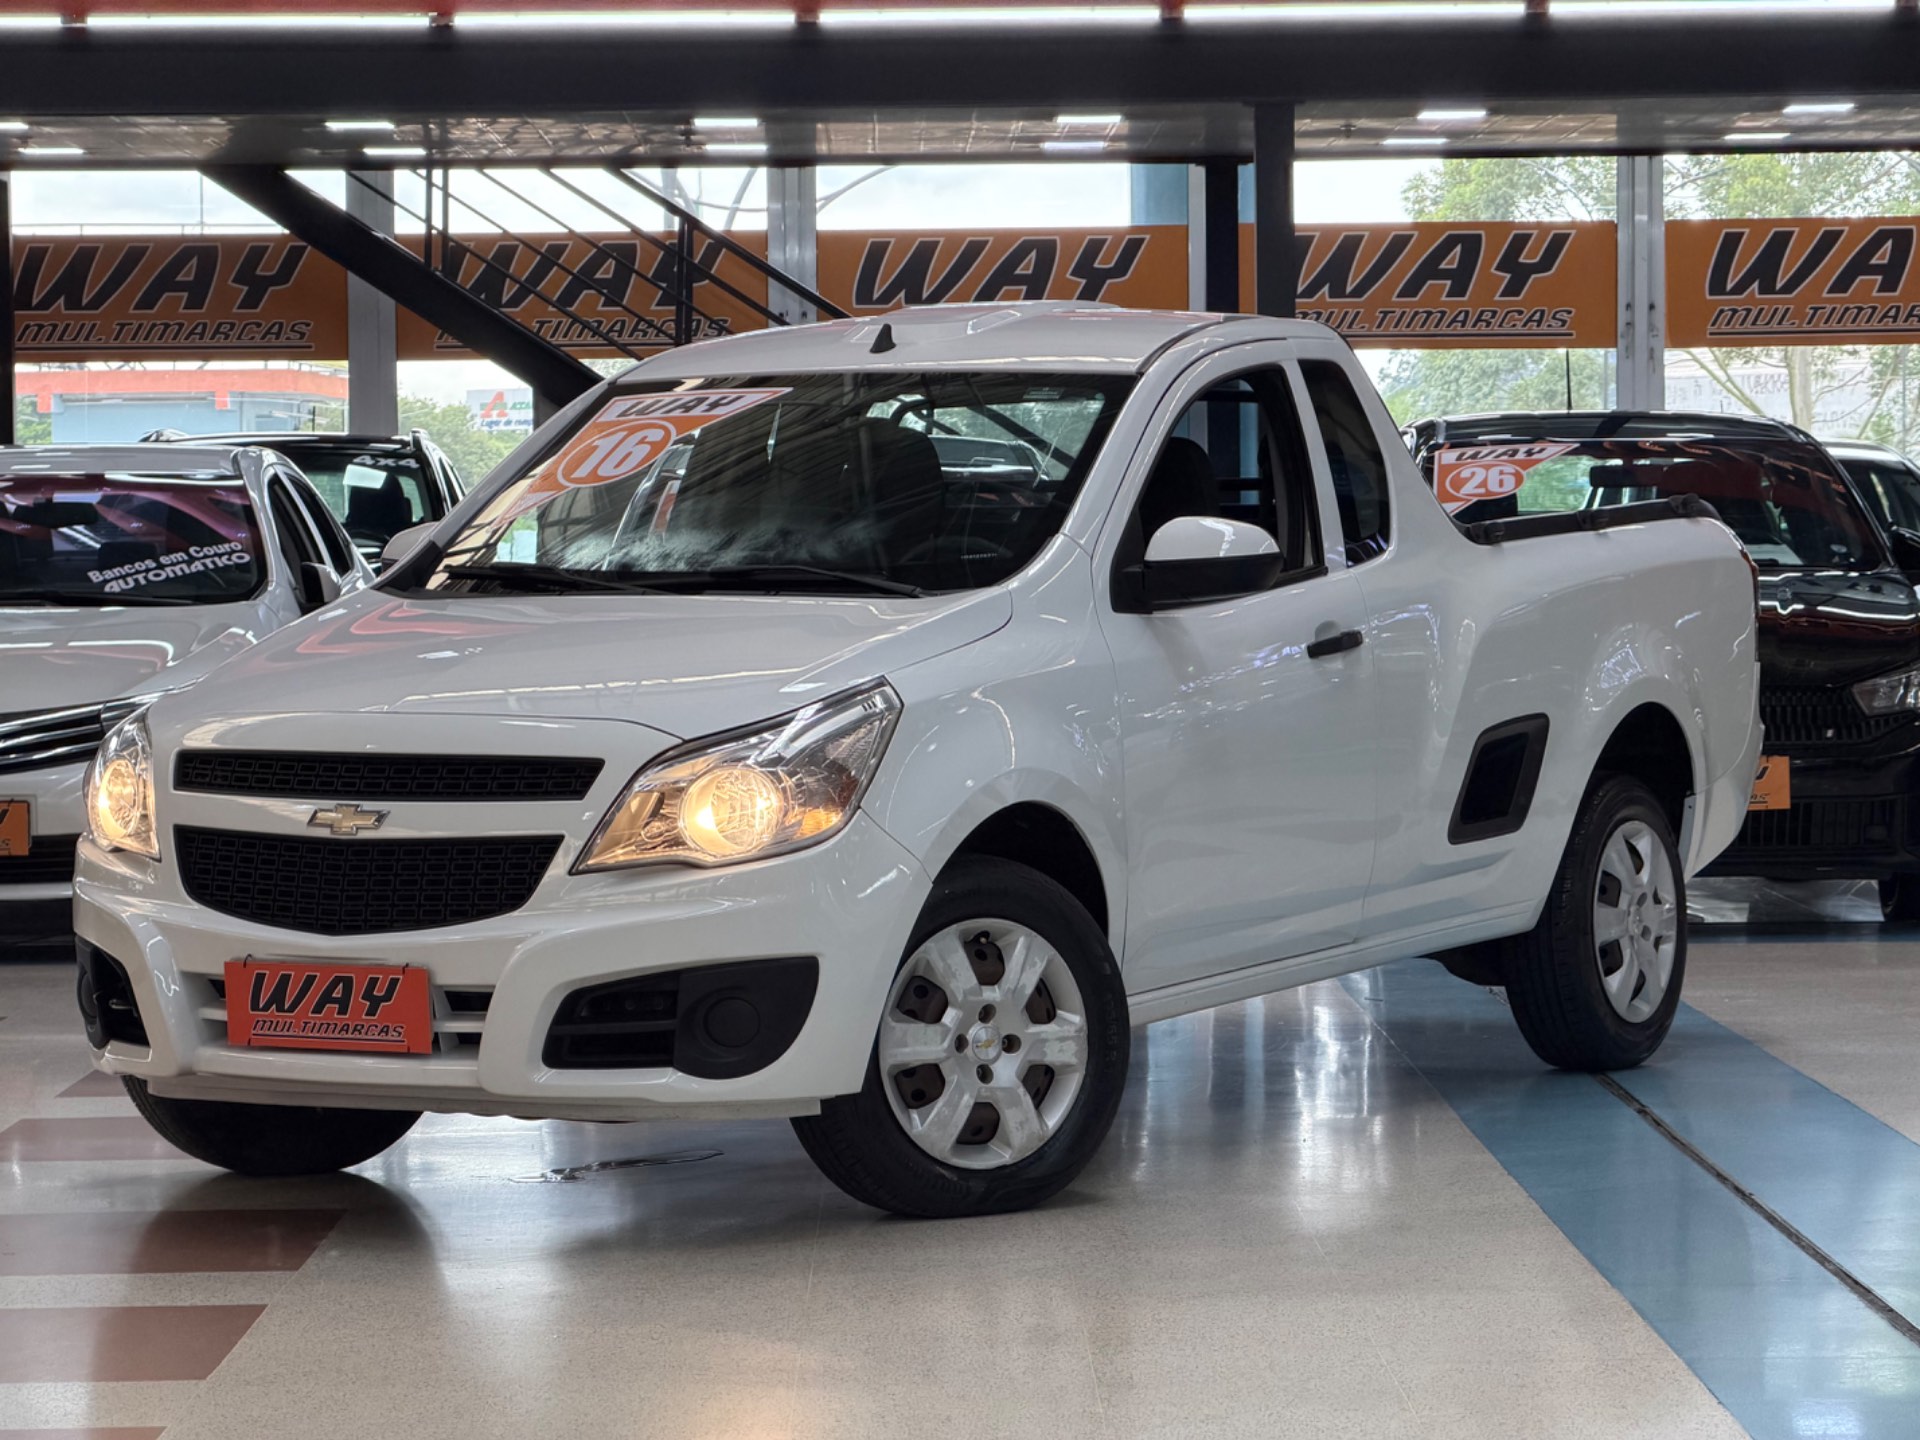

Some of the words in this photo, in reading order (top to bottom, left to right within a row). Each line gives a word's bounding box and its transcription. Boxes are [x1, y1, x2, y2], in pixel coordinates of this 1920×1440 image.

[13, 242, 311, 313] WAY
[448, 240, 727, 312] WAY
[852, 234, 1151, 308] WAY
[1294, 229, 1577, 302] WAY
[16, 319, 314, 344] MULTIMARCAS
[615, 394, 746, 418] WAY
[570, 428, 665, 478] 16
[1455, 446, 1548, 461] WAY
[1460, 465, 1516, 495] 26
[87, 558, 157, 583] Bancos
[159, 551, 188, 565] em
[188, 541, 242, 558] Couro
[249, 970, 402, 1019] WAY
[252, 1018, 406, 1038] MULTIMARCAS
